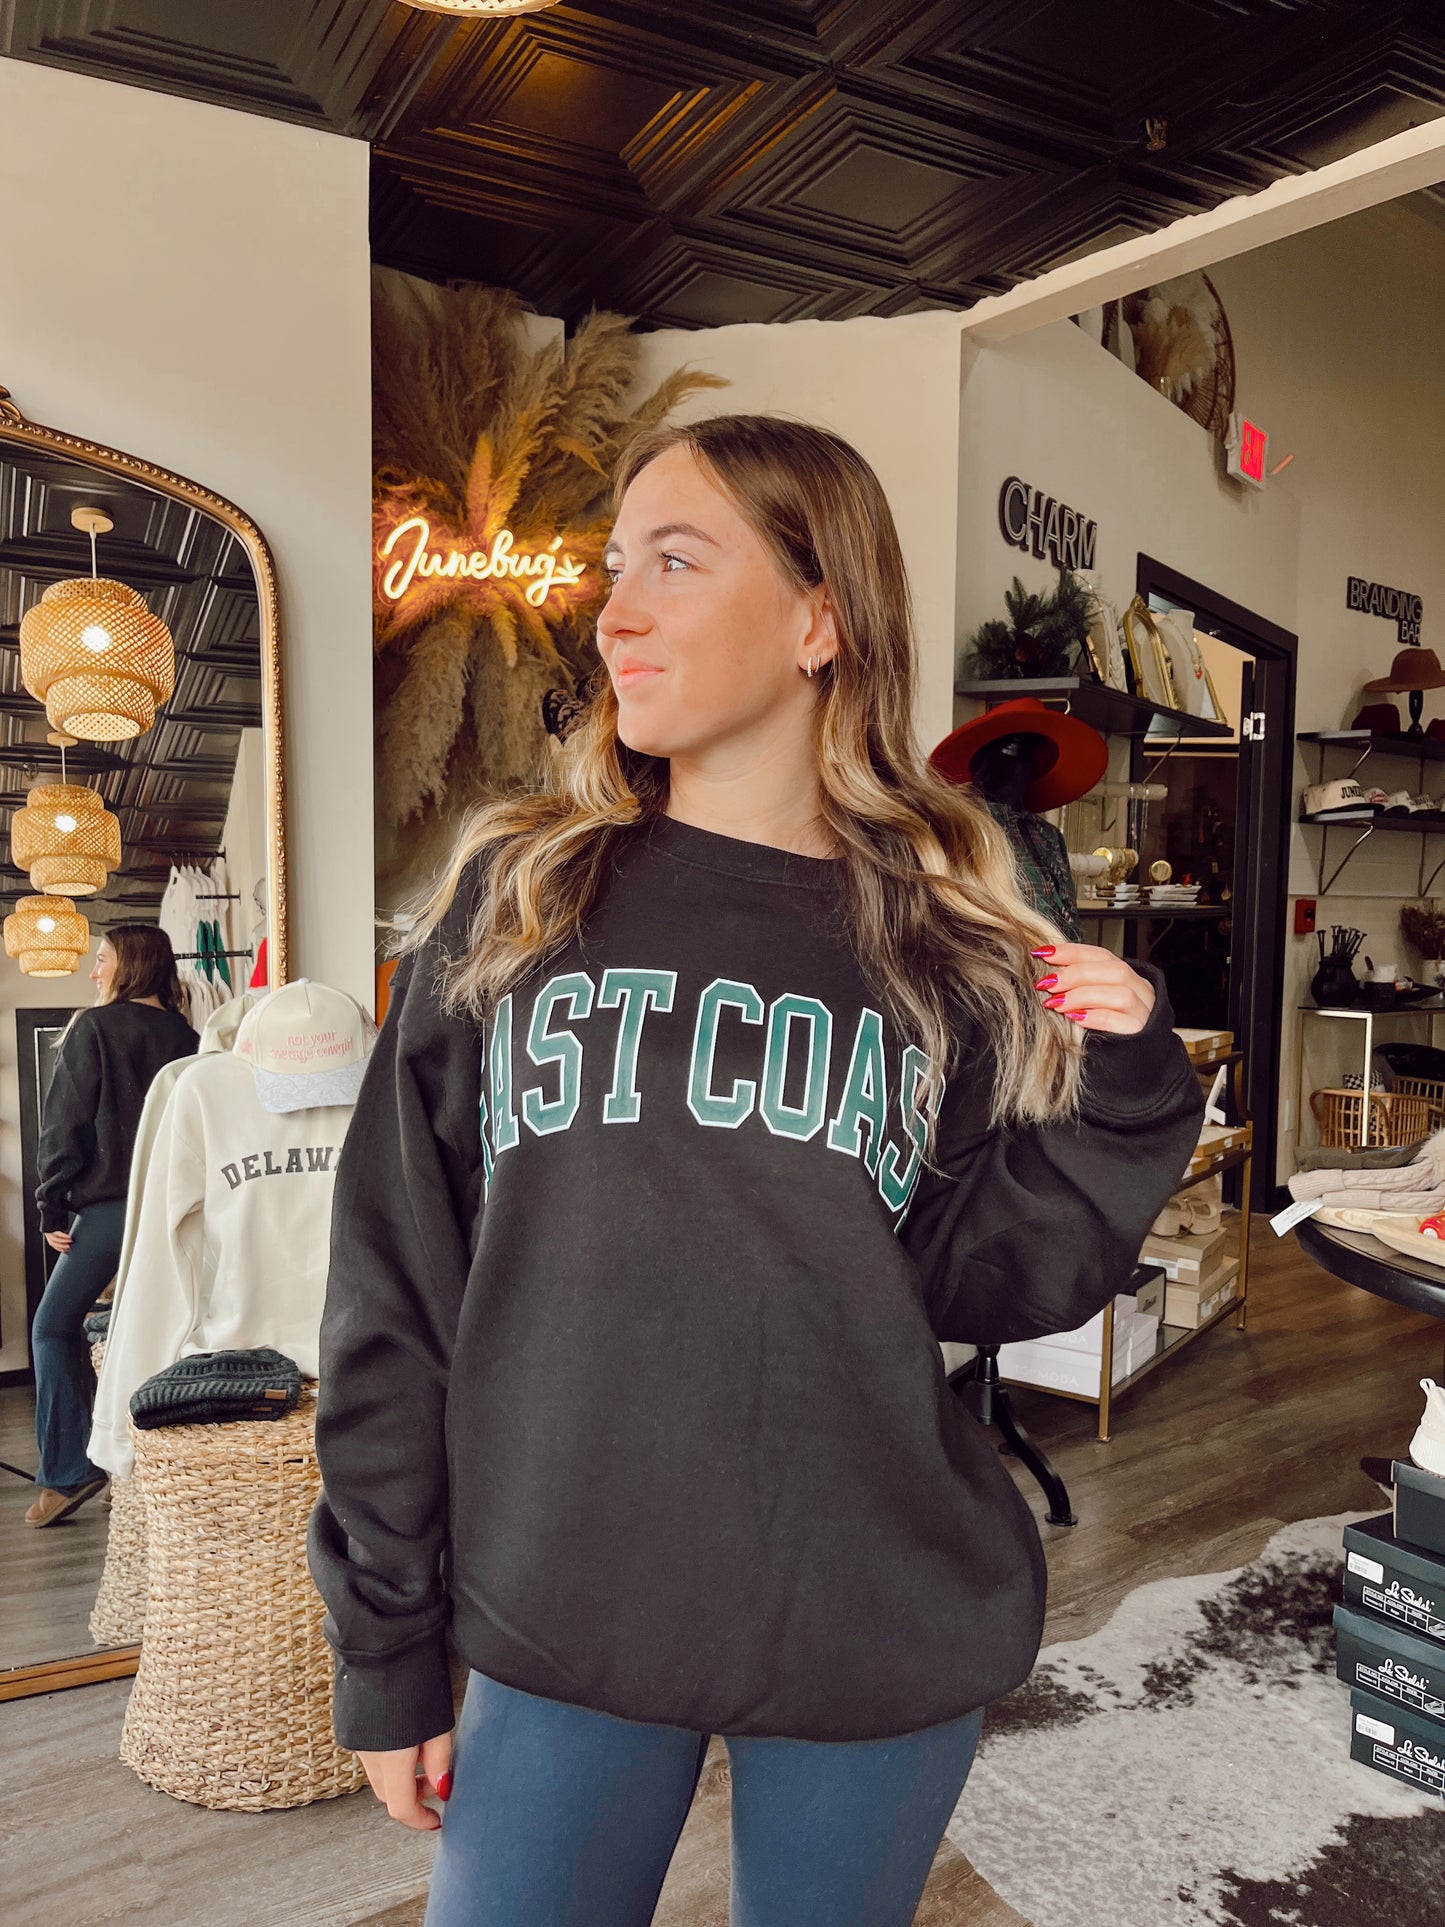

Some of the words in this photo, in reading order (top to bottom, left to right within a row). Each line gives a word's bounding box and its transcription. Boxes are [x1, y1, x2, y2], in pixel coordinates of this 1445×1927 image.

[998, 476, 1097, 571] CHARM
[1346, 576, 1423, 625] BRANDING
[1397, 620, 1421, 647] BAR
[287, 1034, 306, 1047] not
[309, 1031, 336, 1049] your
[316, 1037, 354, 1057] cowgirl
[480, 968, 679, 1204] AST
[686, 978, 946, 1234] COAS
[221, 1146, 343, 1191] DELAW
